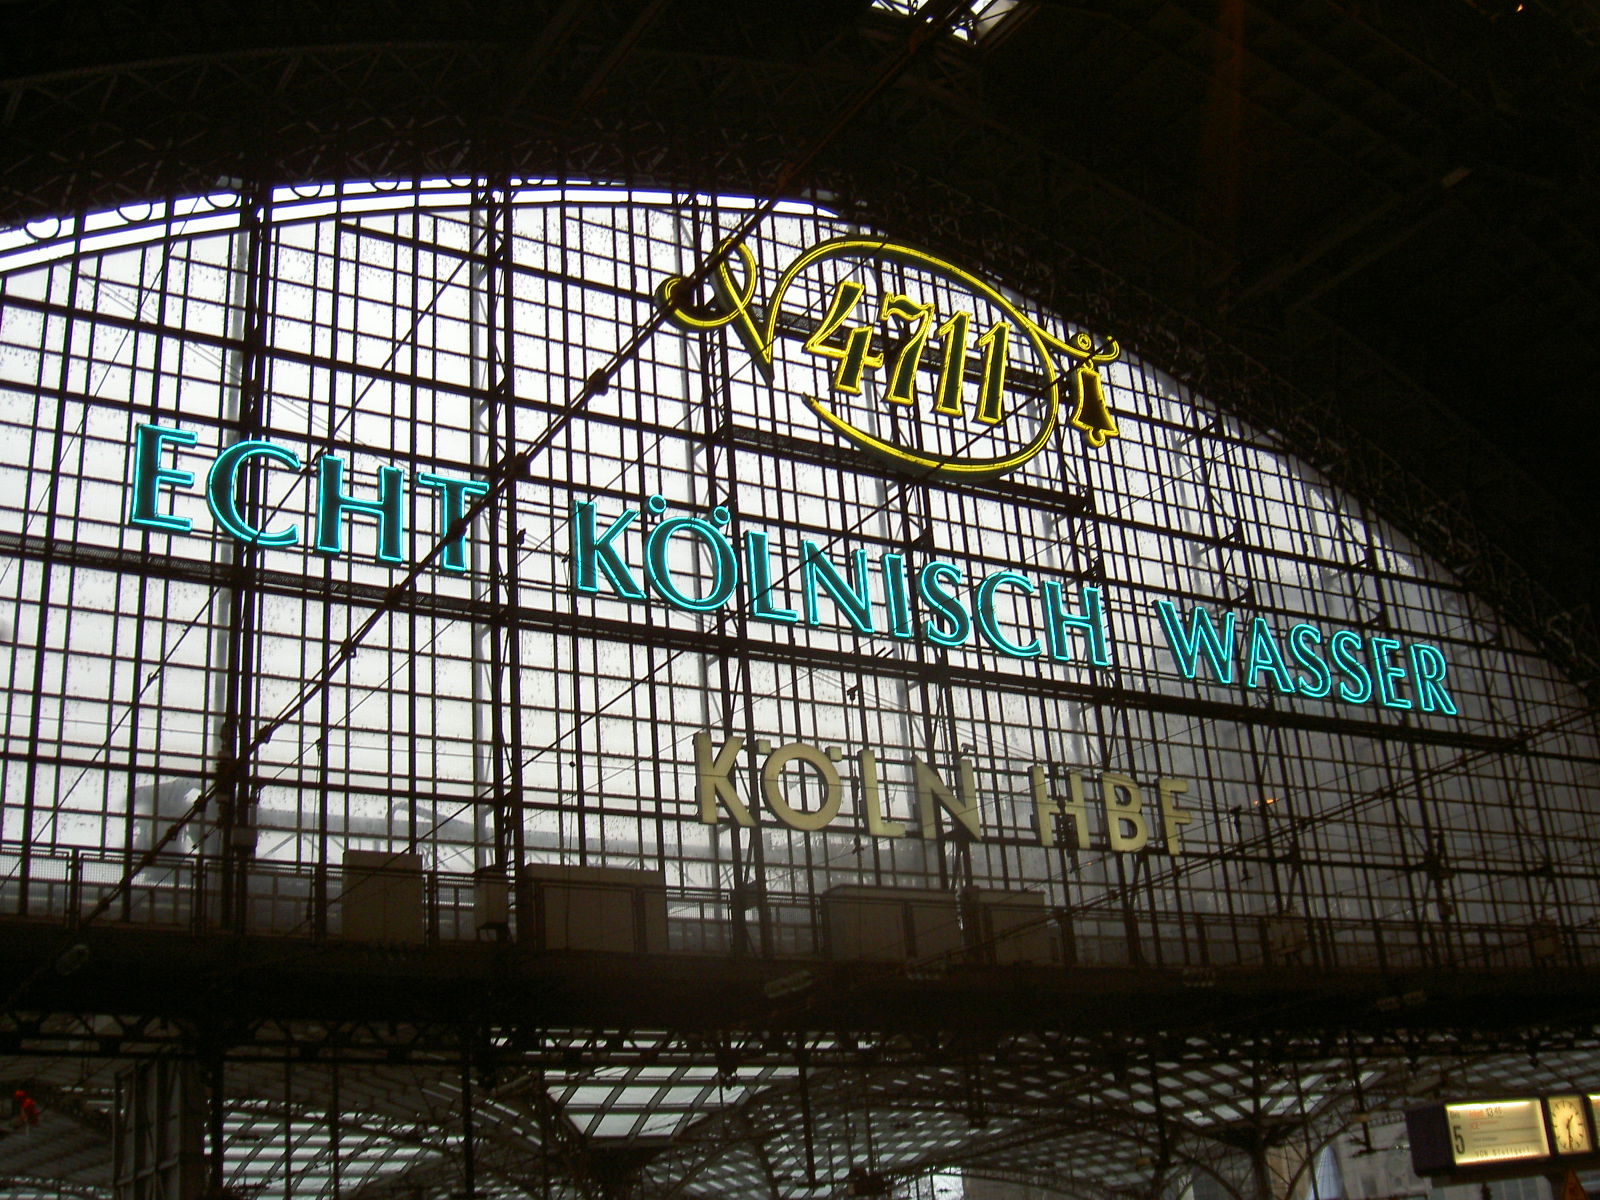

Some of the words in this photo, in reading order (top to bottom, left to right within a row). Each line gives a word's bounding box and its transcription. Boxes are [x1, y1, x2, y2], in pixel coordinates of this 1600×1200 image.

[801, 280, 1011, 425] 4711
[130, 422, 490, 574] ECHT
[571, 493, 1113, 668] KÖLNISCH
[1152, 596, 1459, 716] WASSER
[692, 730, 983, 842] KÖLN
[1028, 763, 1193, 857] HBF
[1453, 1125, 1466, 1155] 5
